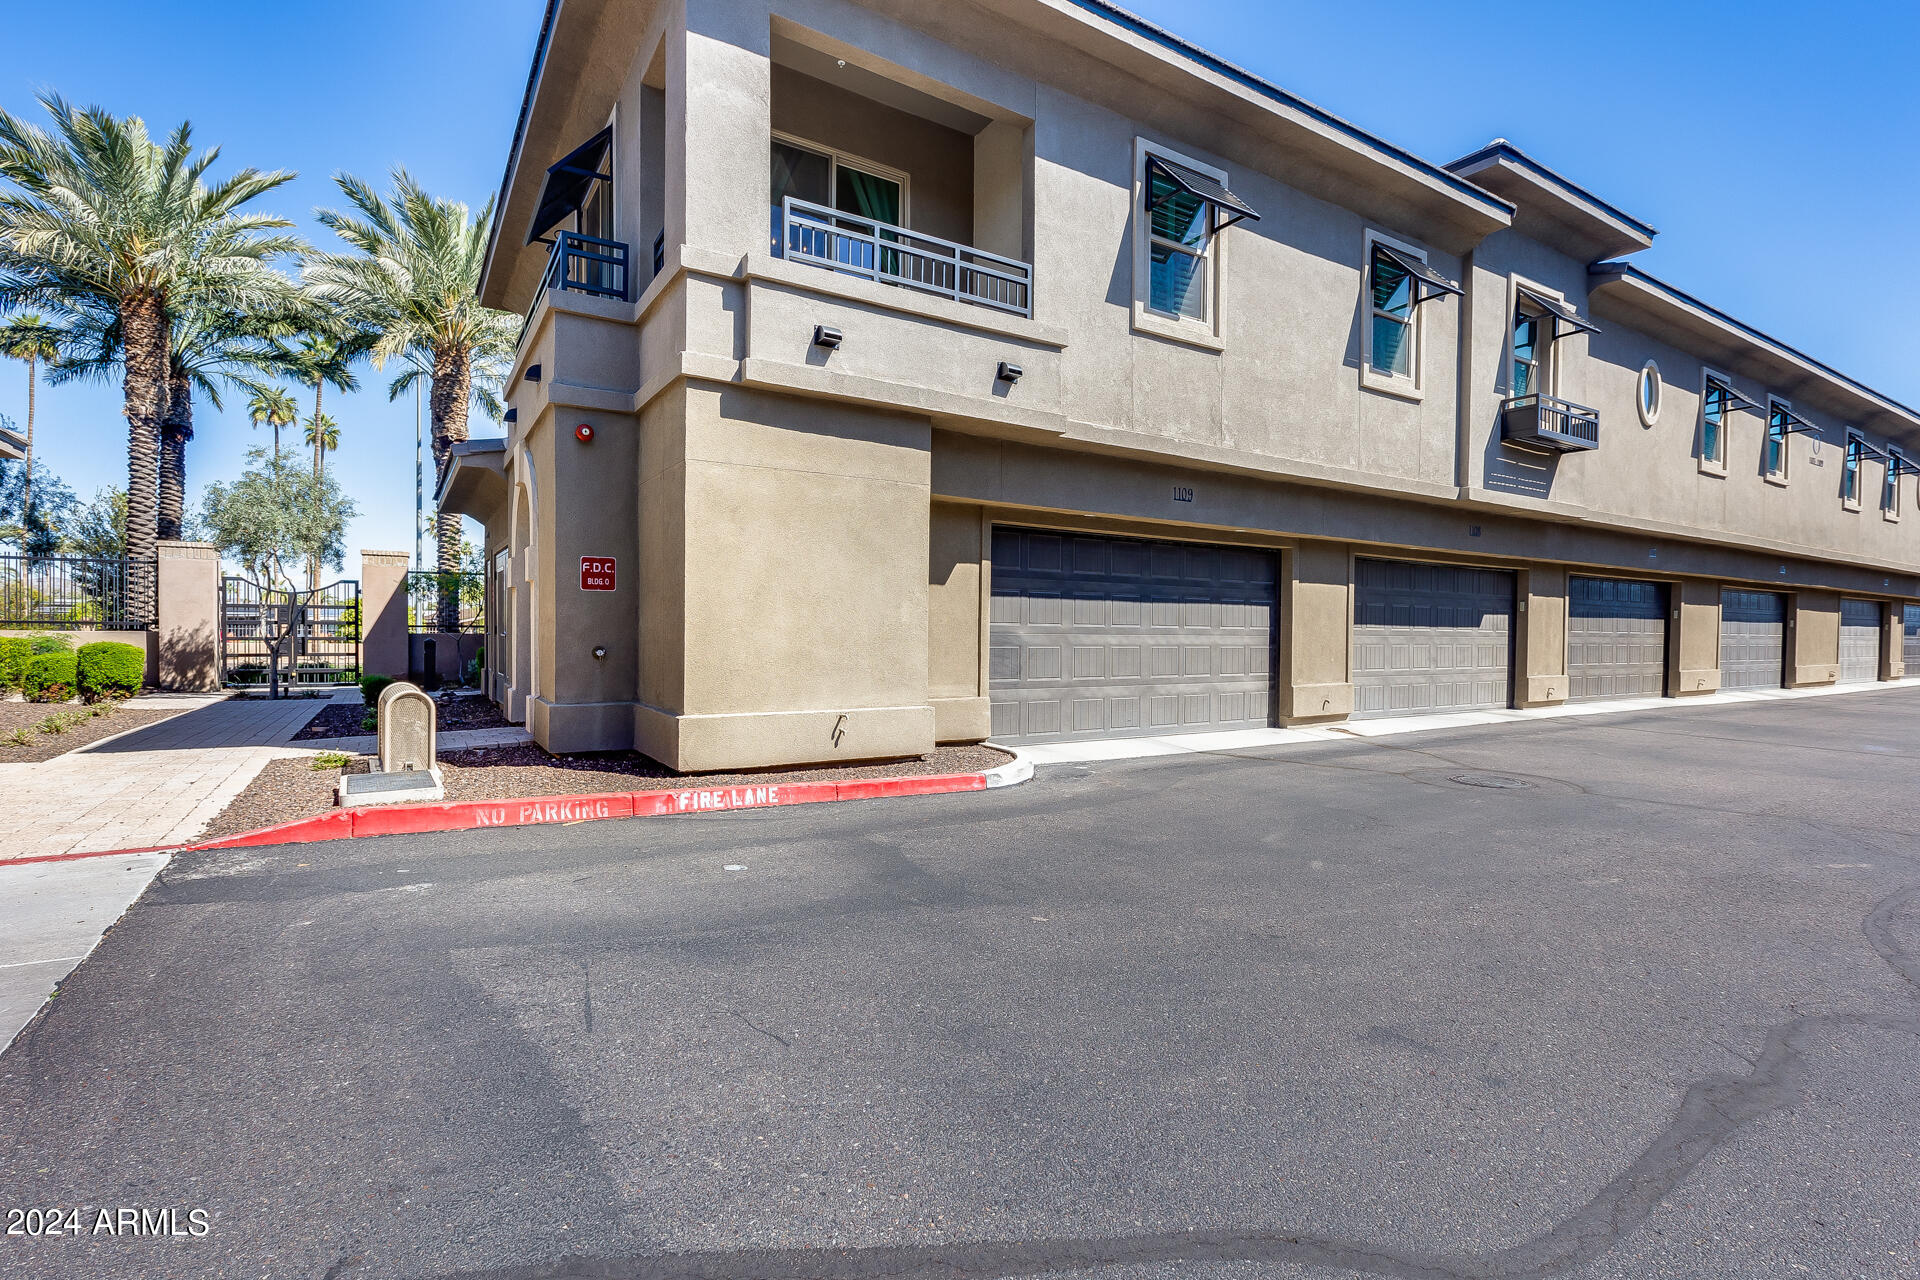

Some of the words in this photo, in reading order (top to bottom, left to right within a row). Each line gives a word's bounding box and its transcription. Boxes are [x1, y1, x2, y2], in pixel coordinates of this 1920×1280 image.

[1173, 486, 1194, 502] 1109
[582, 562, 615, 573] F.D.C.
[680, 791, 723, 810] FIRE
[731, 786, 779, 806] LANE
[475, 806, 505, 825] NO
[519, 800, 609, 822] PARKING
